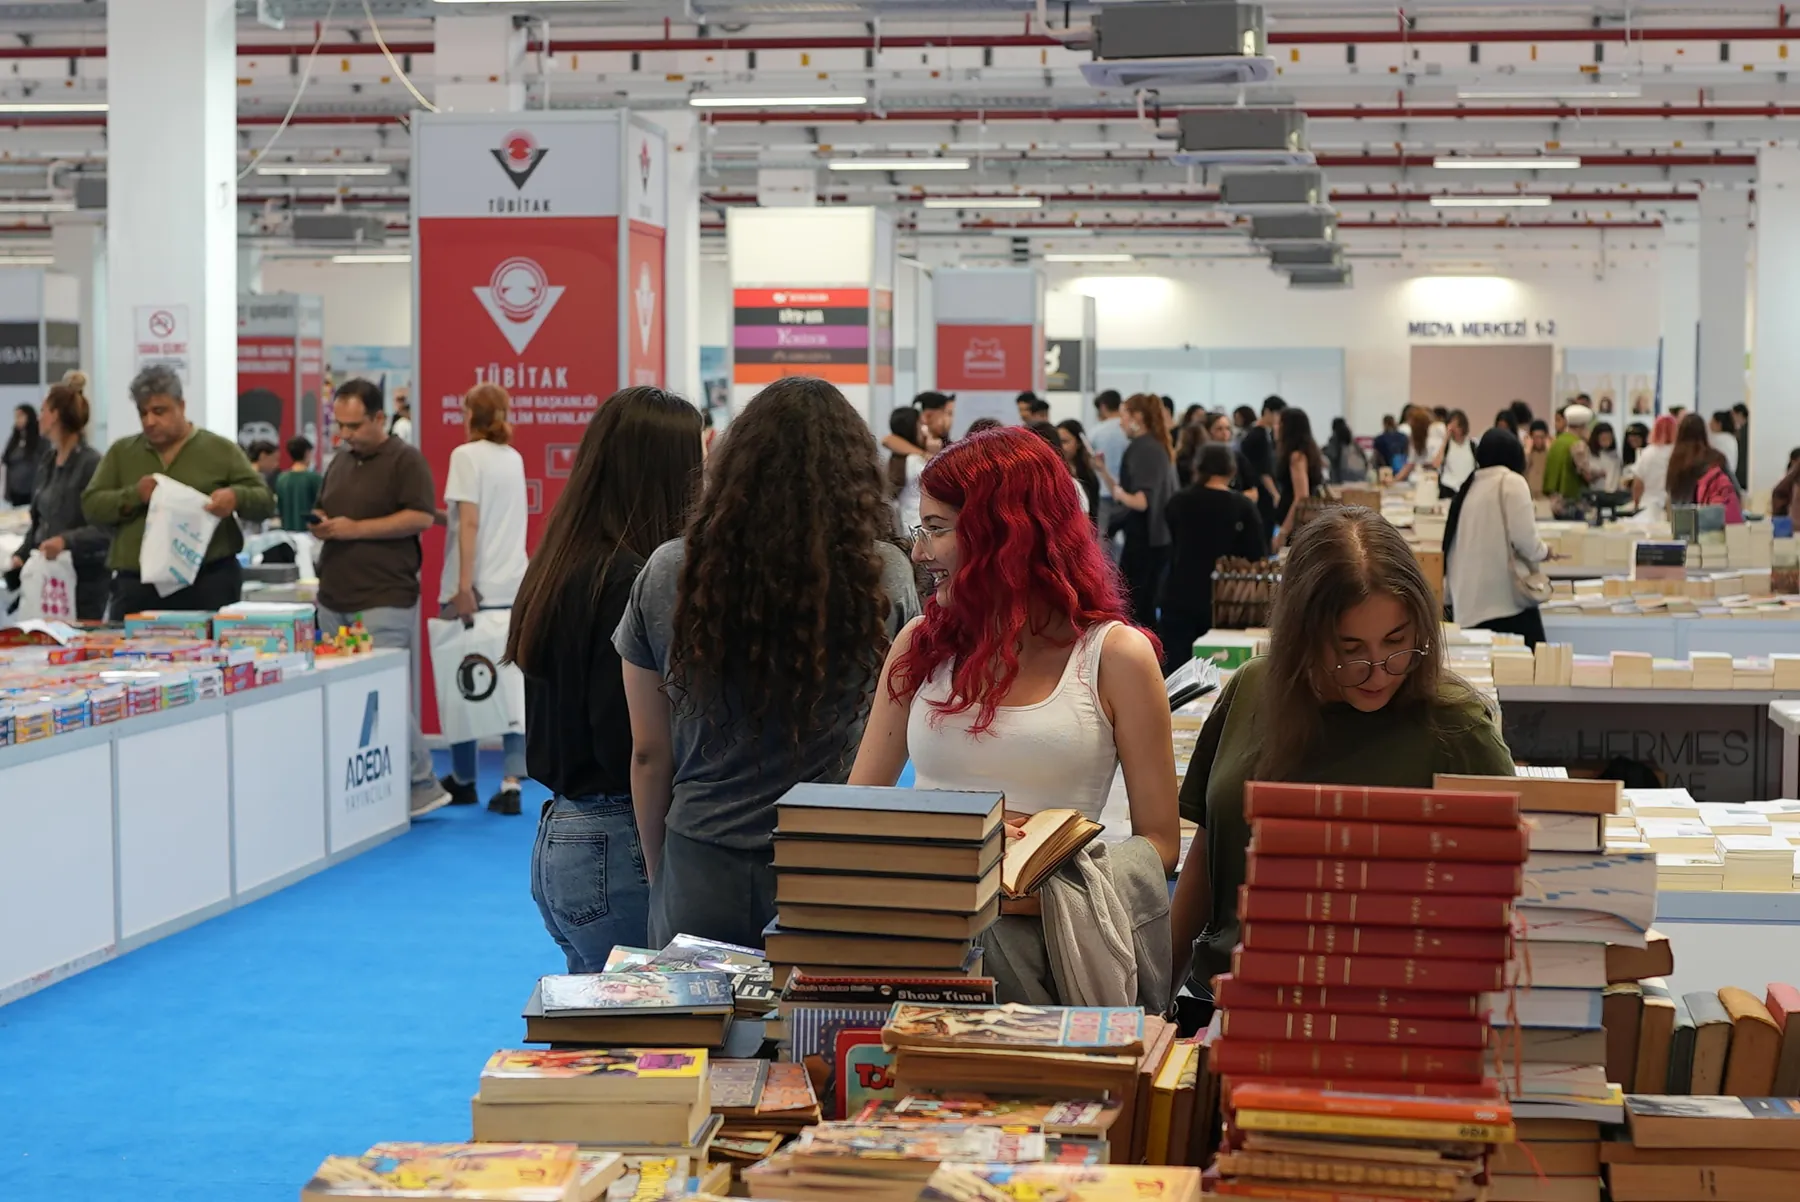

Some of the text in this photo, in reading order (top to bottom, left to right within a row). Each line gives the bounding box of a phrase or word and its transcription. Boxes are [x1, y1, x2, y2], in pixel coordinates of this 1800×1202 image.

[489, 197, 551, 212] TÜBİTAK
[1408, 321, 1455, 336] MEDYA
[1462, 318, 1526, 336] MERKEZİ
[474, 363, 568, 389] TÜBİTAK
[1577, 729, 1749, 767] HERMES
[345, 745, 391, 791] ADEDA
[898, 989, 986, 1002] Show Time!
